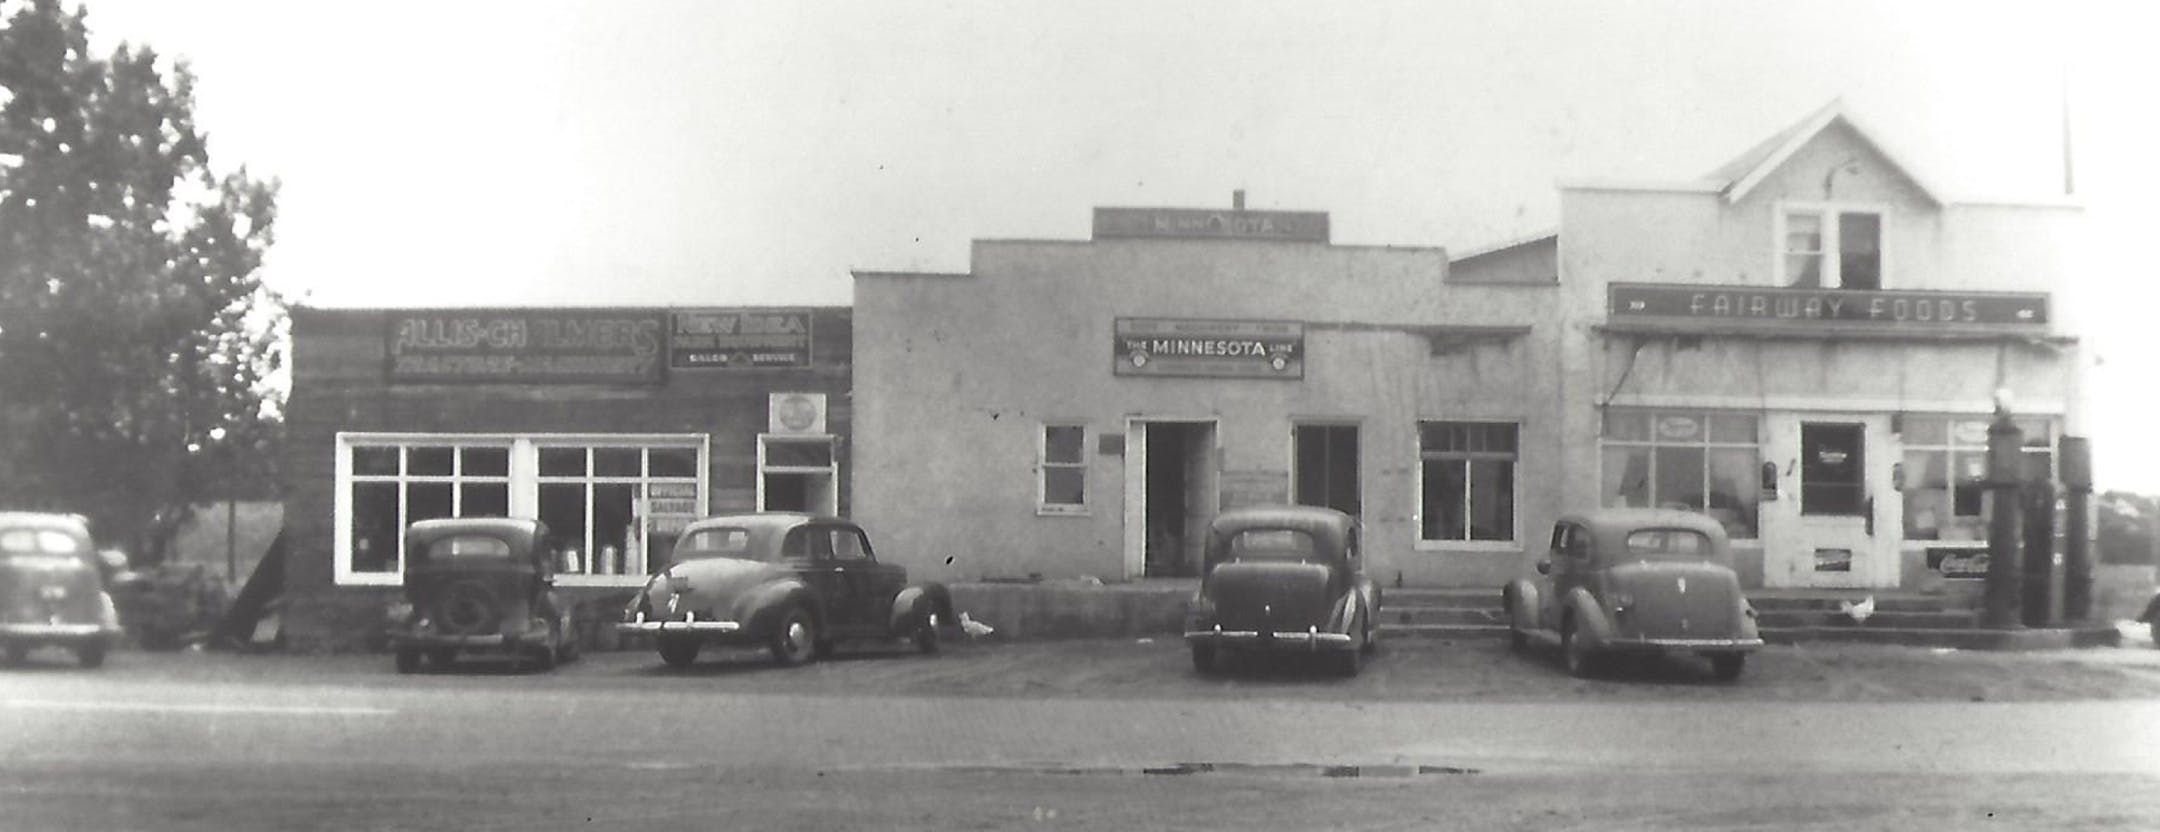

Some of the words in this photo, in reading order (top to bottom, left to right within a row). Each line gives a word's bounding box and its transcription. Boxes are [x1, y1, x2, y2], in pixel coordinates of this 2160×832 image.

[1690, 294, 1845, 318] FAIRWAY
[1869, 297, 1978, 321] FOODS
[1126, 340, 1147, 350] THE
[1152, 339, 1266, 357] MINNESOTA
[1269, 343, 1293, 353] LINE
[752, 353, 796, 363] SERVICE
